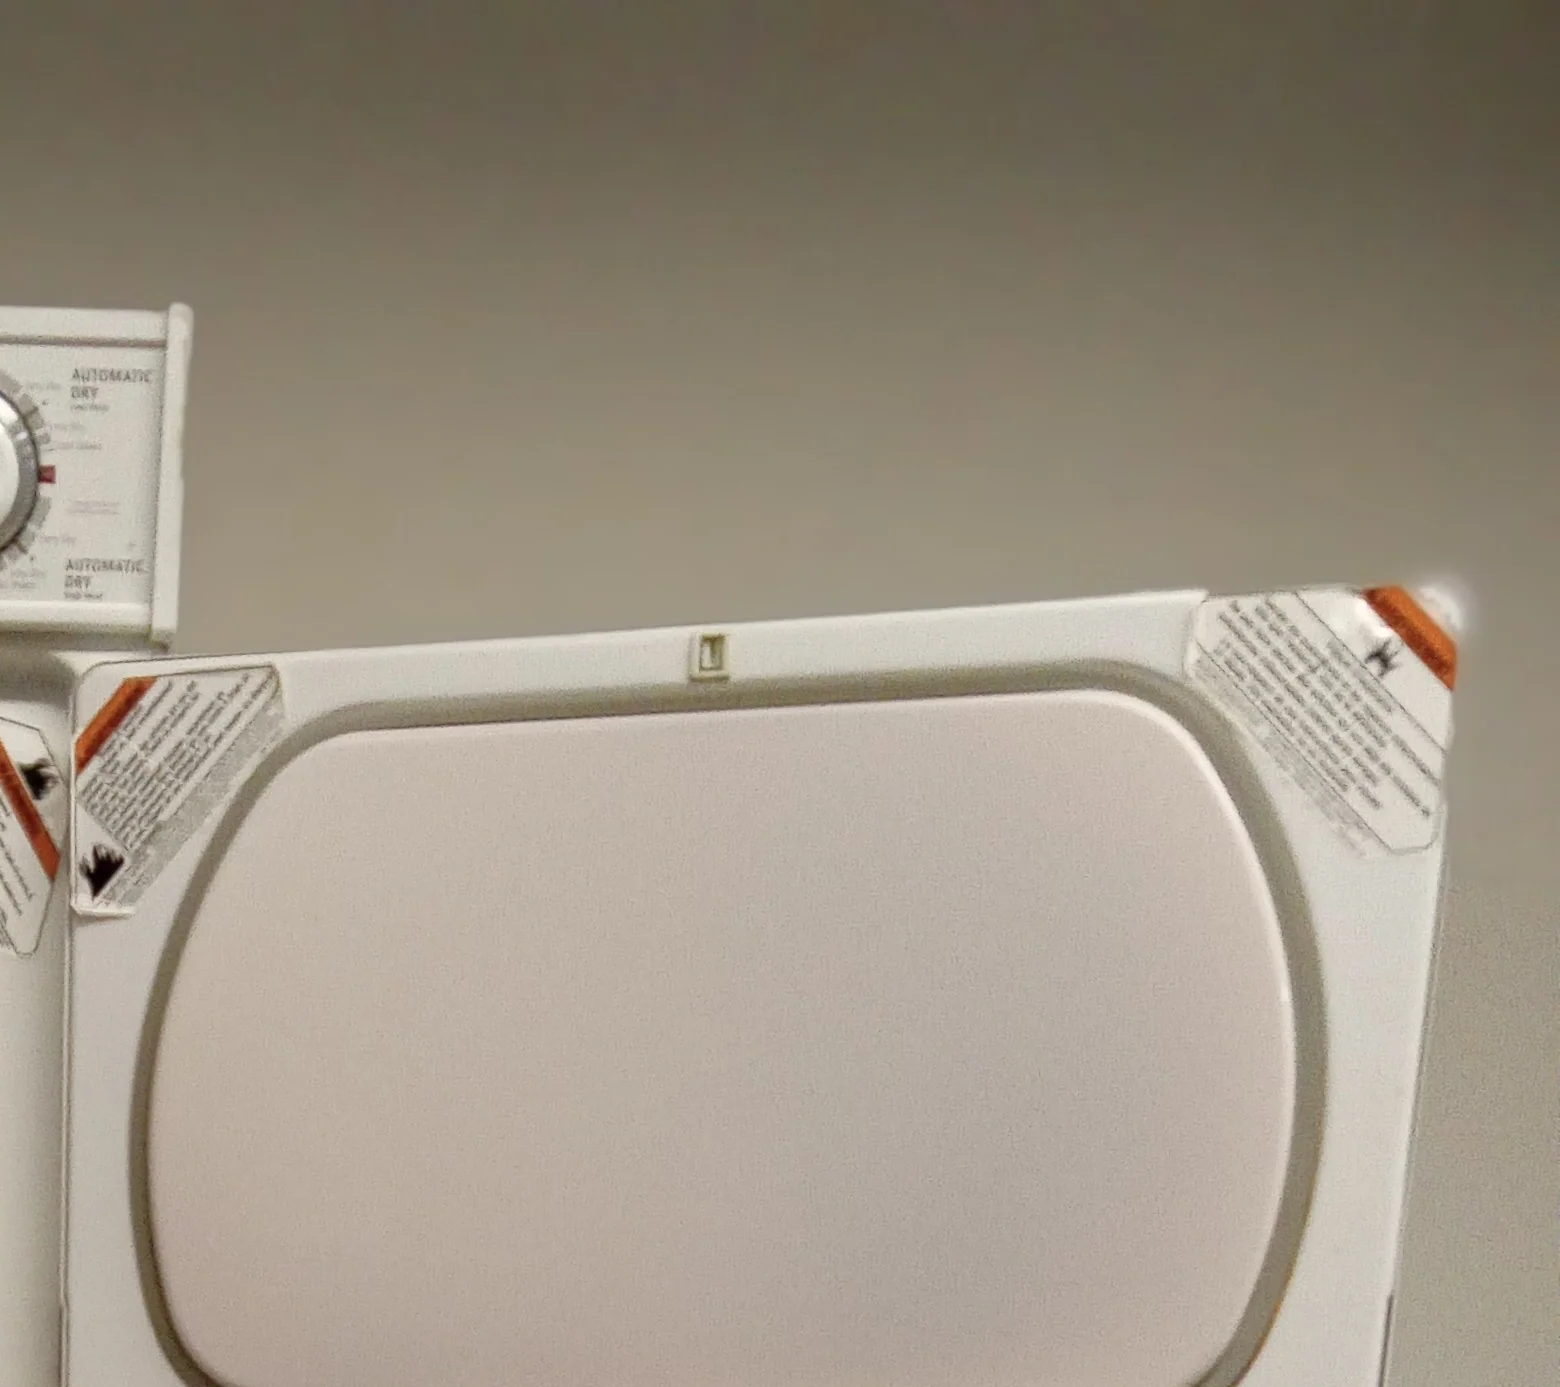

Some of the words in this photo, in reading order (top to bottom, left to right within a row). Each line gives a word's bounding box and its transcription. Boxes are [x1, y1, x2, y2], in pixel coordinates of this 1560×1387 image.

[71, 367, 153, 383] AUTOMATIC
[70, 386, 99, 400] DRY
[65, 558, 147, 574] AUTOMATIC
[64, 576, 92, 589] DRY
